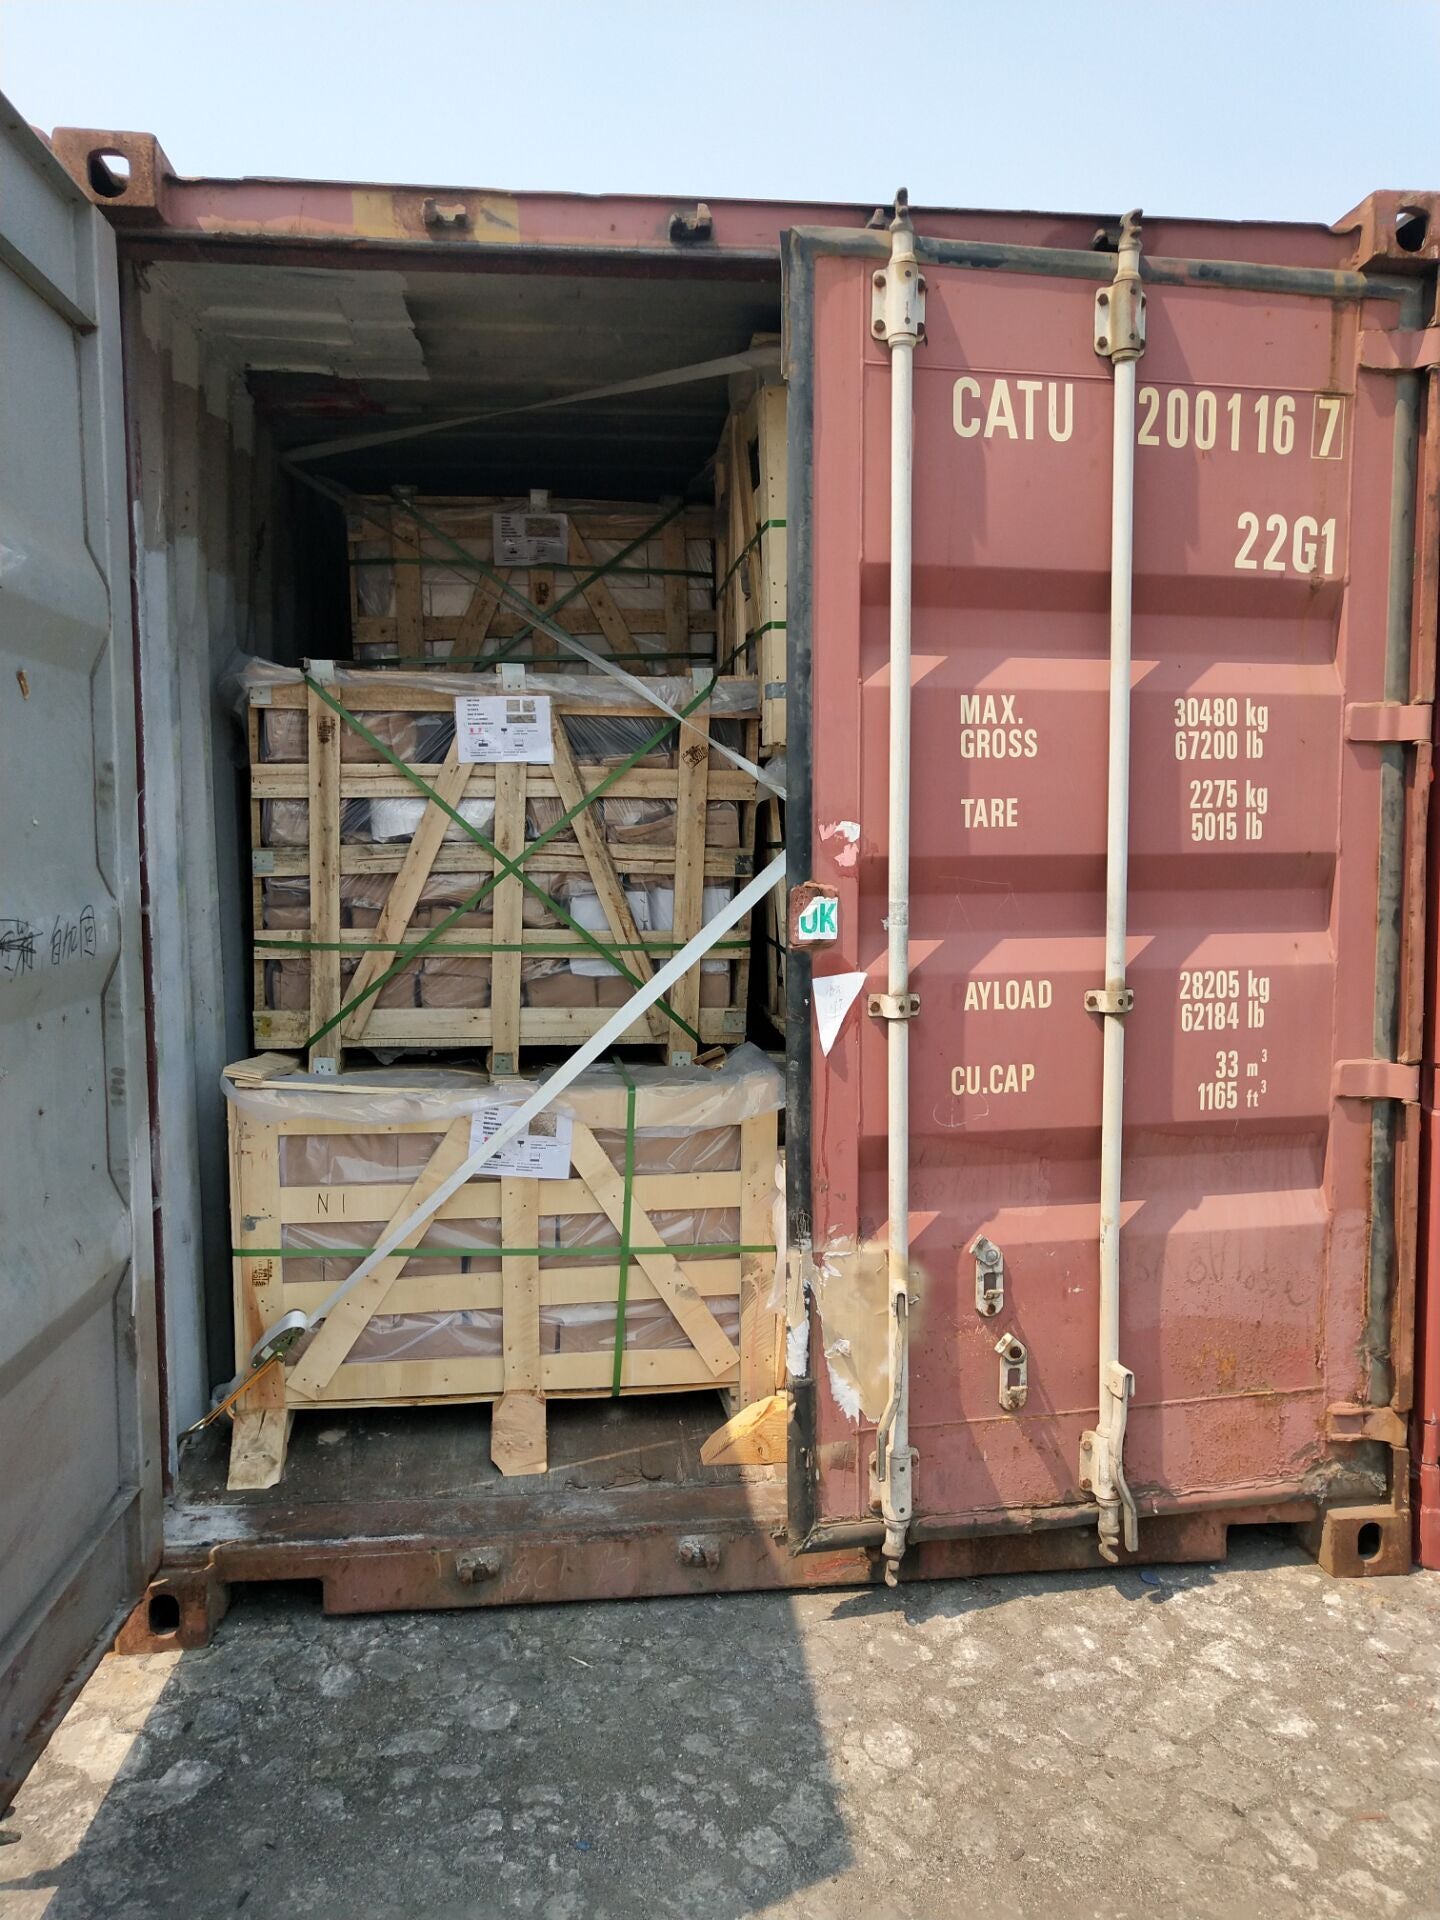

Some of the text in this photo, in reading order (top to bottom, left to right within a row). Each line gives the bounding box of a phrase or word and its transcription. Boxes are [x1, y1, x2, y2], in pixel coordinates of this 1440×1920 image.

[953, 377, 1341, 457] CATU 200116 7
[1235, 511, 1336, 574] 22G1
[960, 695, 1024, 725] MAX.
[1174, 698, 1269, 732] 30480 kg
[960, 728, 1038, 758] GROSS
[1174, 731, 1264, 760] 67200 lb
[1189, 780, 1269, 814] 2275 kg
[960, 798, 1018, 828] TARE
[1191, 812, 1263, 841] 5015 lb
[1179, 970, 1270, 1003] 28205 kg
[1181, 1001, 1265, 1032] 62184 lb
[951, 1064, 1035, 1095] CU.CAP
[1215, 1050, 1239, 1079] 33
[1198, 1081, 1238, 1111] 1165
